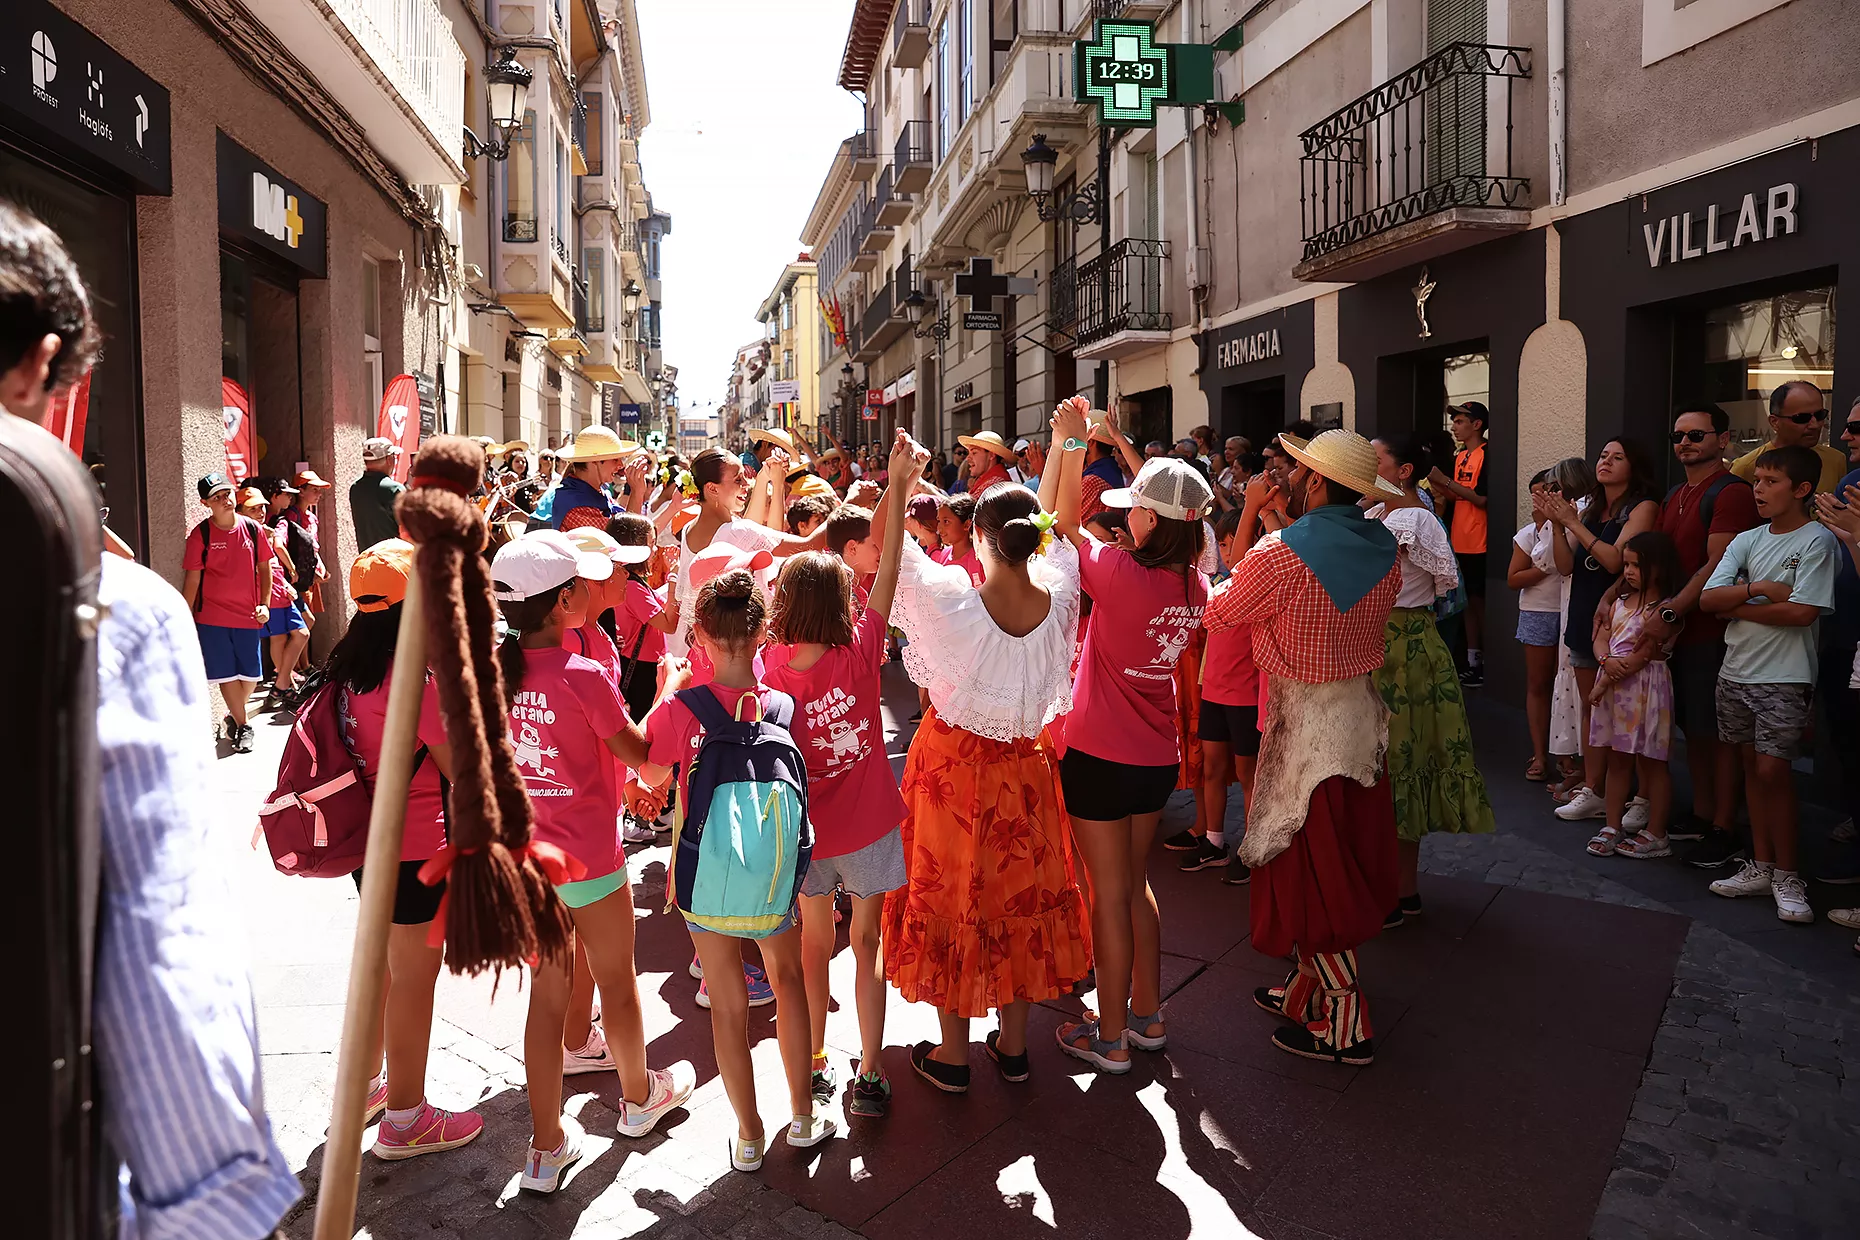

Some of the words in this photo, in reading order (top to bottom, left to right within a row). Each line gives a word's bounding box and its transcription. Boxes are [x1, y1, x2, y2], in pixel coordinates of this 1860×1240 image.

[1099, 62, 1154, 80] 12:39
[32, 85, 59, 109] PROTEST
[79, 107, 113, 141] Haglöfs
[1643, 182, 1797, 268] VILLAR
[1217, 328, 1281, 369] FARMACIA
